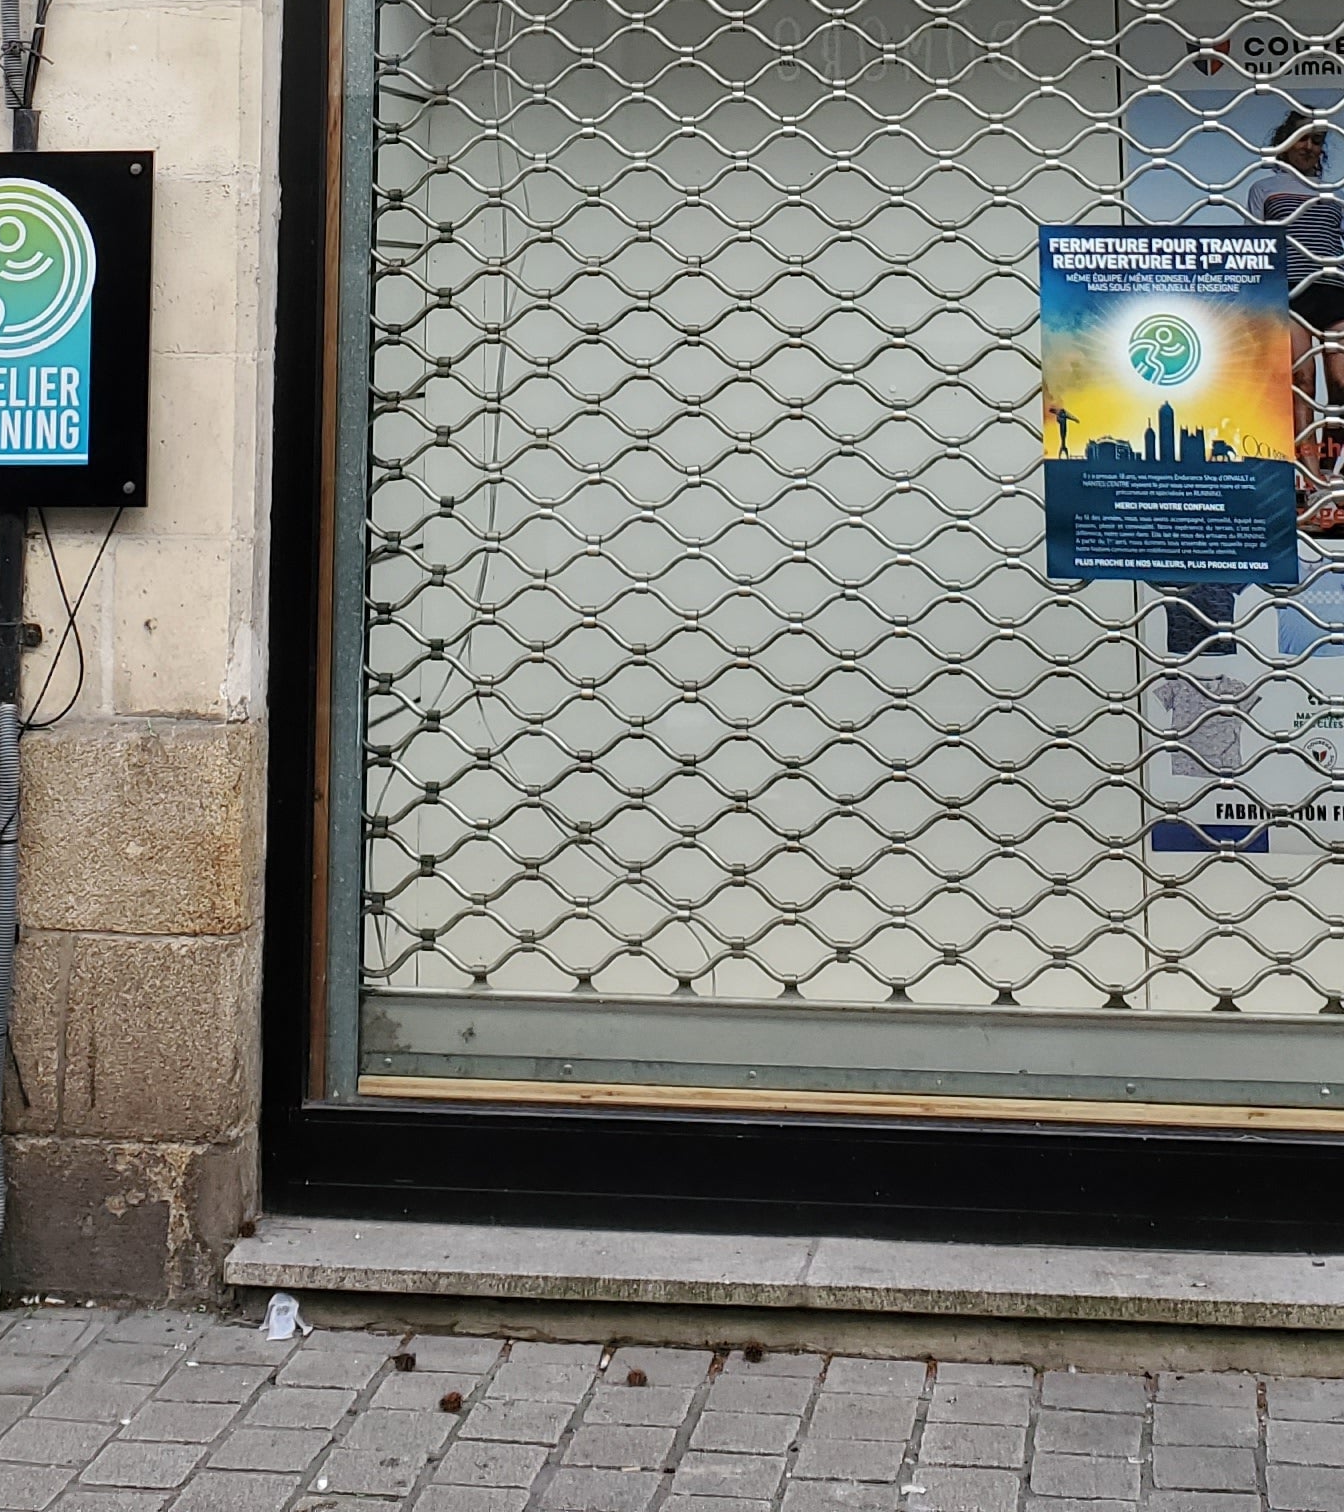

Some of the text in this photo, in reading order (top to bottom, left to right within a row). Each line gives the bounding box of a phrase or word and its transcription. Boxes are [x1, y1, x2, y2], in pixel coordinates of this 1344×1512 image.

[1049, 238, 1277, 253] FERMETURE POUR TRAVAUX
[1053, 255, 1274, 270] REOUVERTURE LE 1ER AVRIL
[1066, 274, 1091, 283] MÊME
[1129, 274, 1154, 283] MÊME
[1156, 274, 1190, 283] CONSEIL
[1197, 274, 1223, 283] MÊME
[1225, 274, 1261, 283] PRODUIT
[1088, 283, 1240, 292] MAIS SOUS UNE NOUVELLE ENSEIGNE
[1114, 502, 1137, 510] MERCI
[1138, 502, 1158, 510] POUR
[1075, 558, 1094, 566] PLUS
[1094, 558, 1123, 566] PROCHE
[1125, 559, 1135, 567] DE
[1136, 559, 1151, 567] NOS
[1188, 560, 1206, 568] PLUS
[1207, 561, 1236, 569] PROCHE
[1238, 561, 1248, 569] DE
[1249, 561, 1269, 569] VOUS
